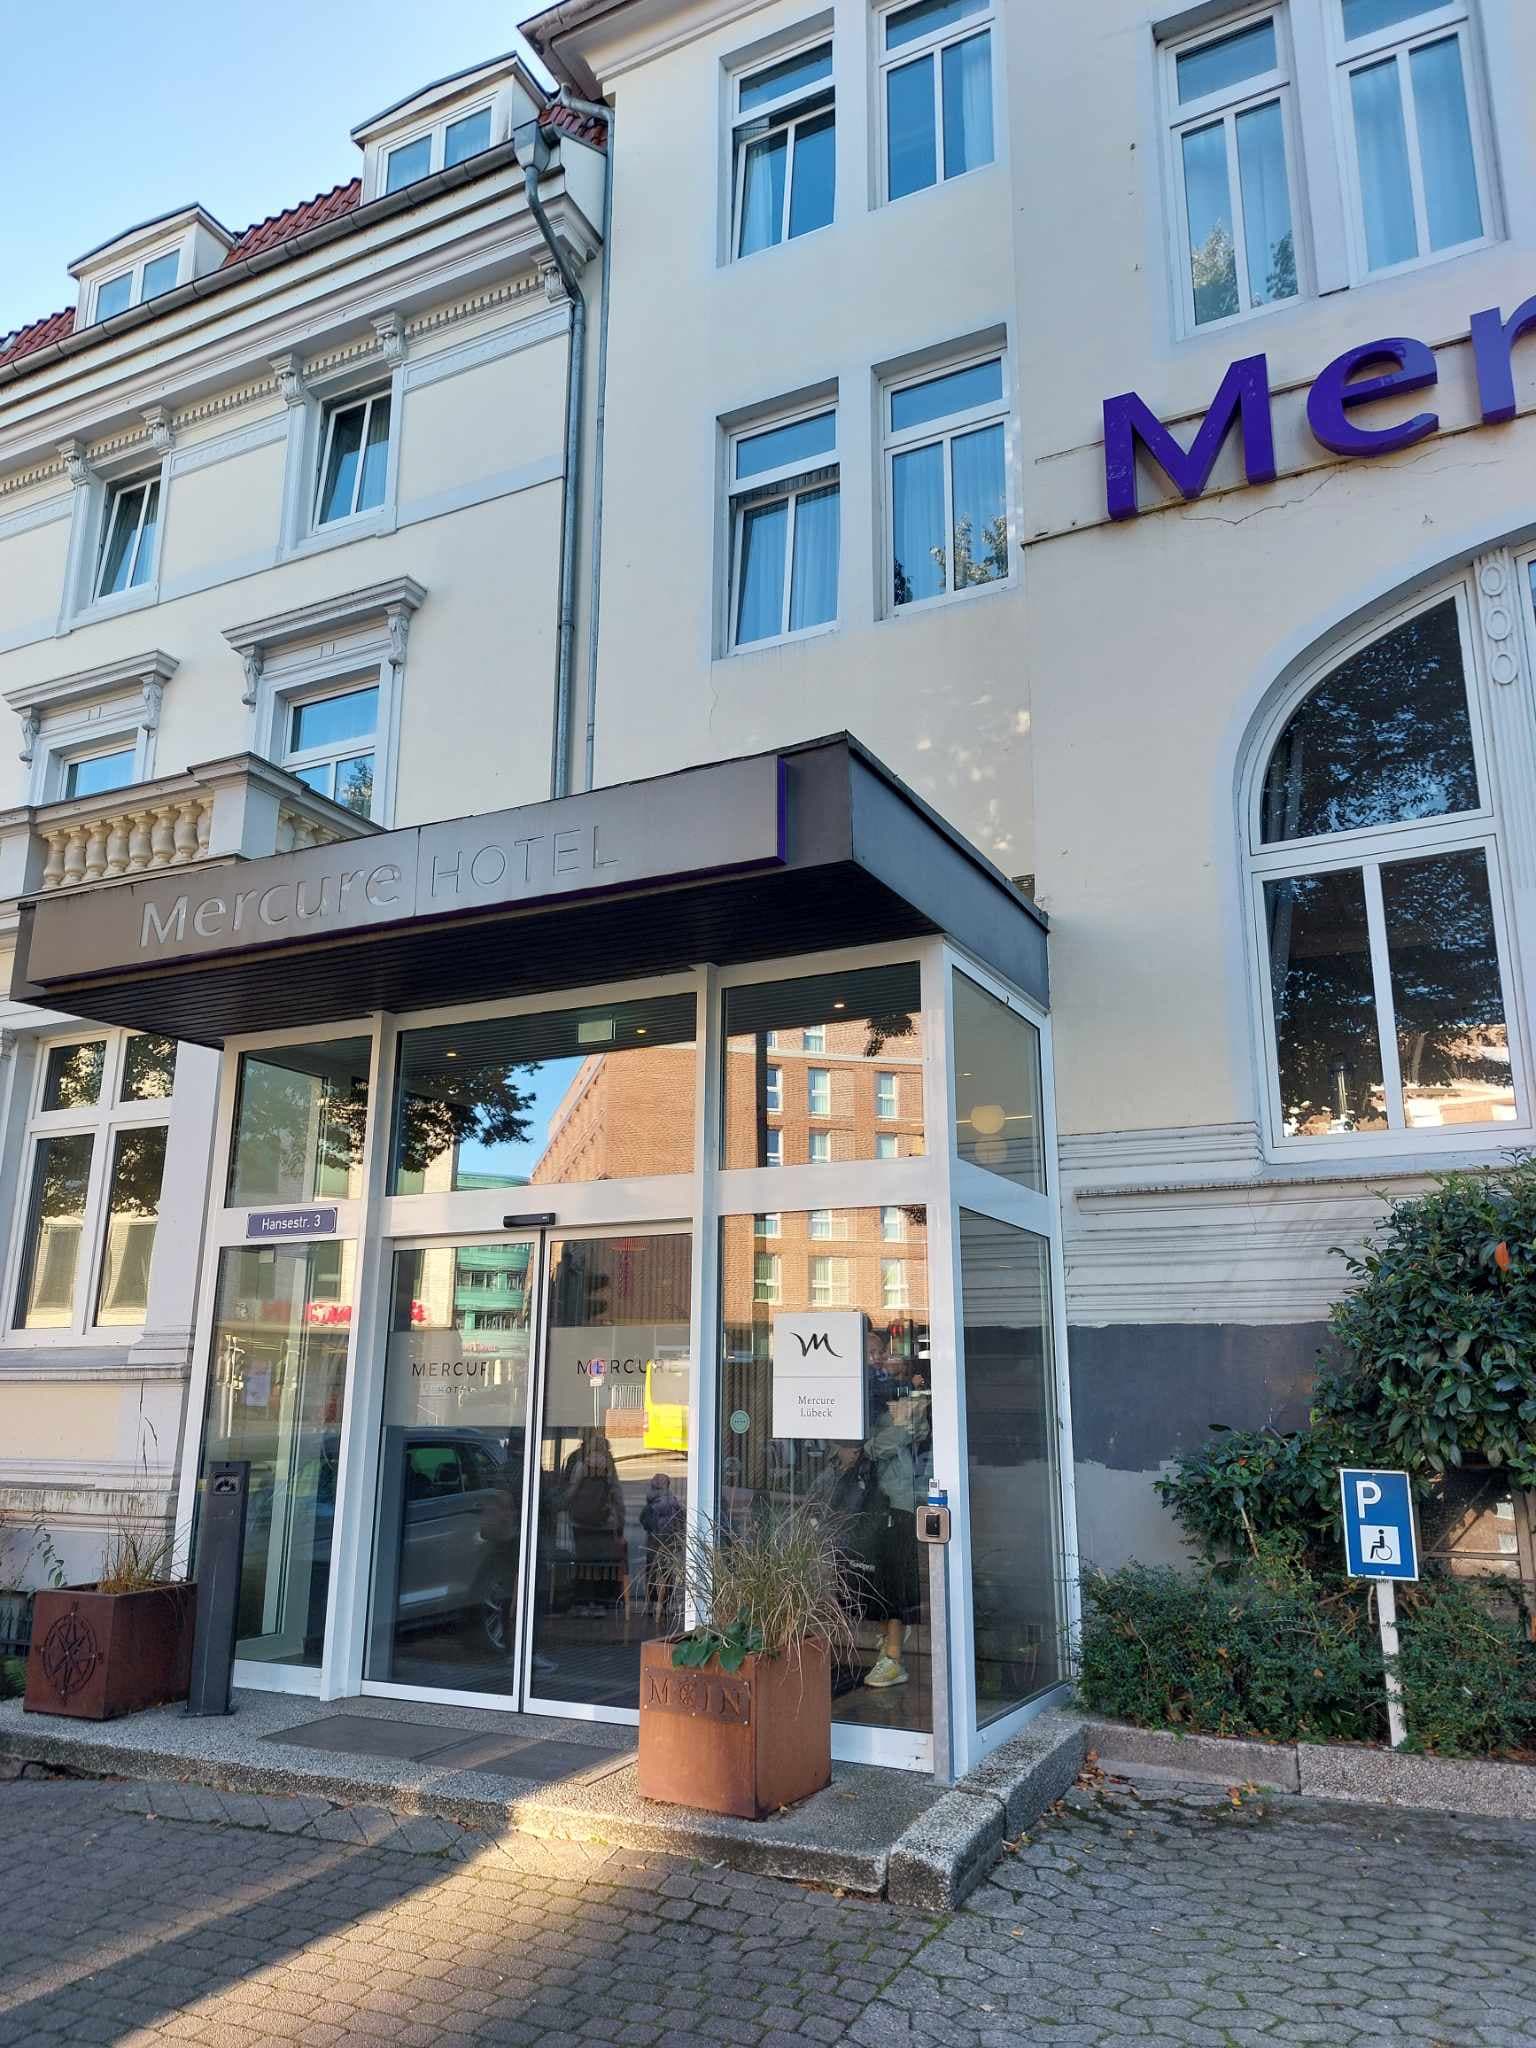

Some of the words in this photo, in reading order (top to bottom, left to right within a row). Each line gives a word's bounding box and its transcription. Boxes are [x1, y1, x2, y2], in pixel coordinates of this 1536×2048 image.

[139, 863, 401, 947] Mercure
[431, 824, 620, 897] HOTEL
[261, 1216, 310, 1231] Hansestr.
[314, 1214, 321, 1227] 3
[798, 1395, 836, 1405] Mercure
[800, 1407, 833, 1418] Lübeck
[1356, 1481, 1382, 1519] P
